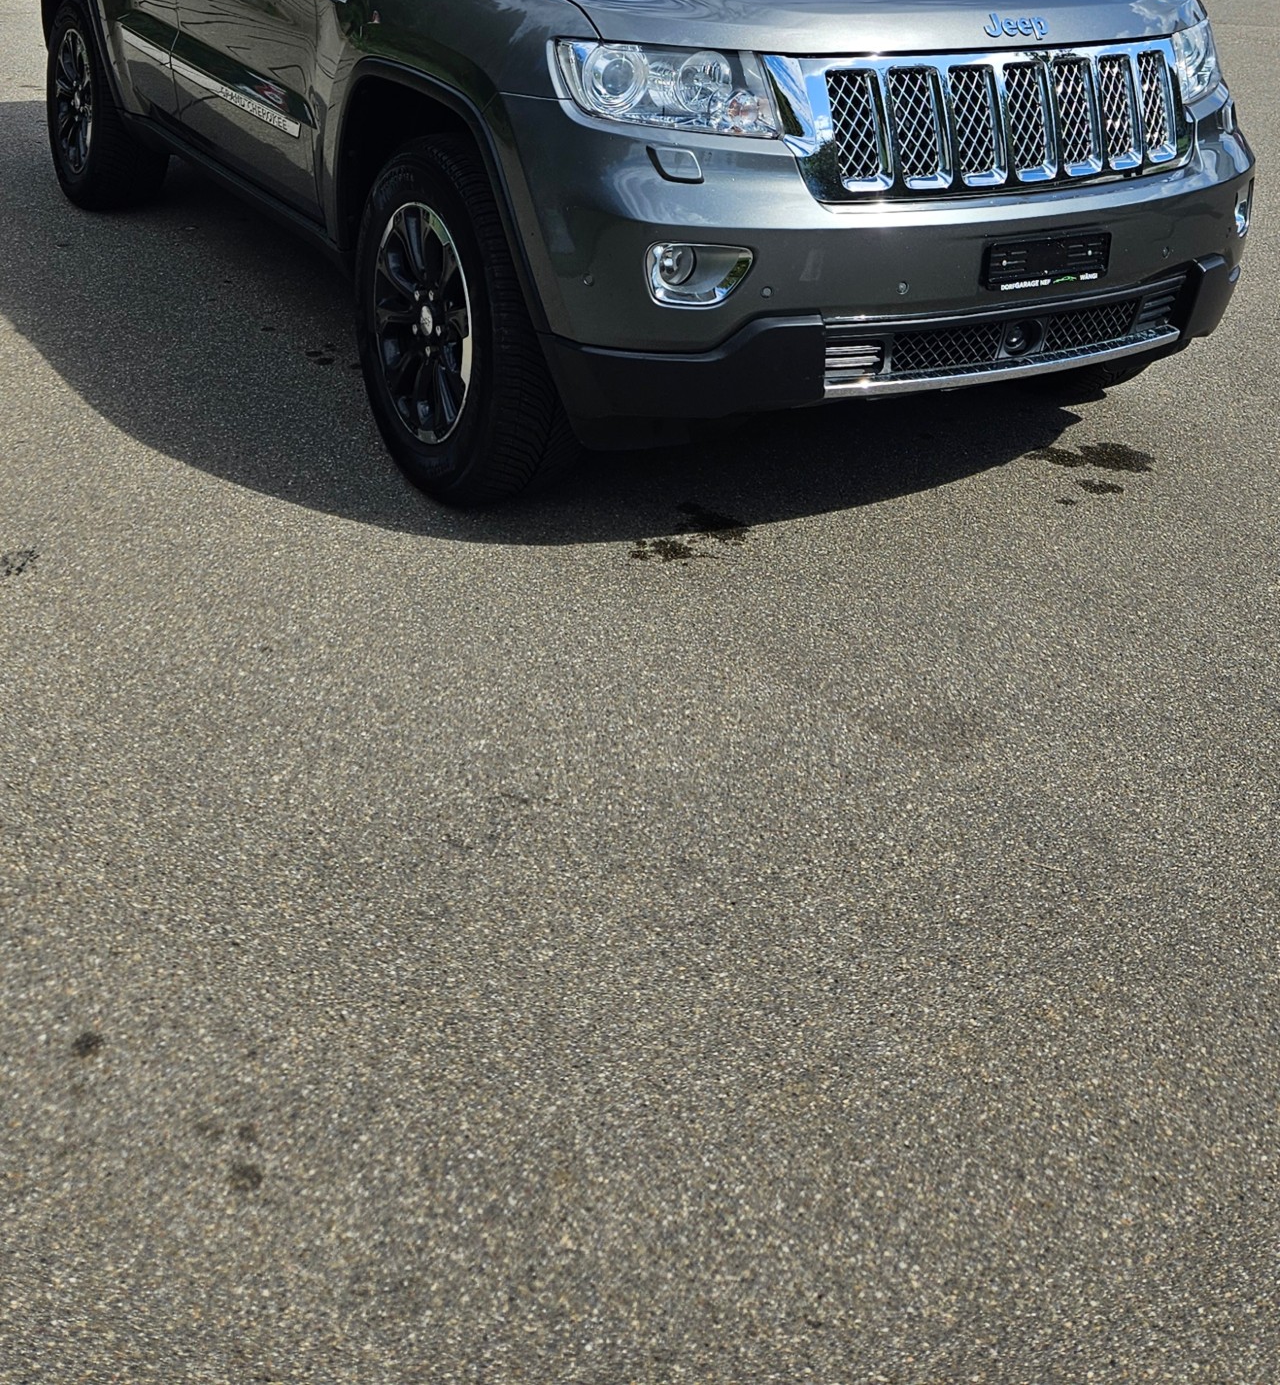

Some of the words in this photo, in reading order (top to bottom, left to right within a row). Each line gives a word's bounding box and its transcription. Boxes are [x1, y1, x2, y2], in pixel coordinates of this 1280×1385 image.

[983, 13, 1049, 40] Jeep
[246, 100, 288, 131] CHEROKEE
[1000, 279, 1039, 290] DORFGARAGE
